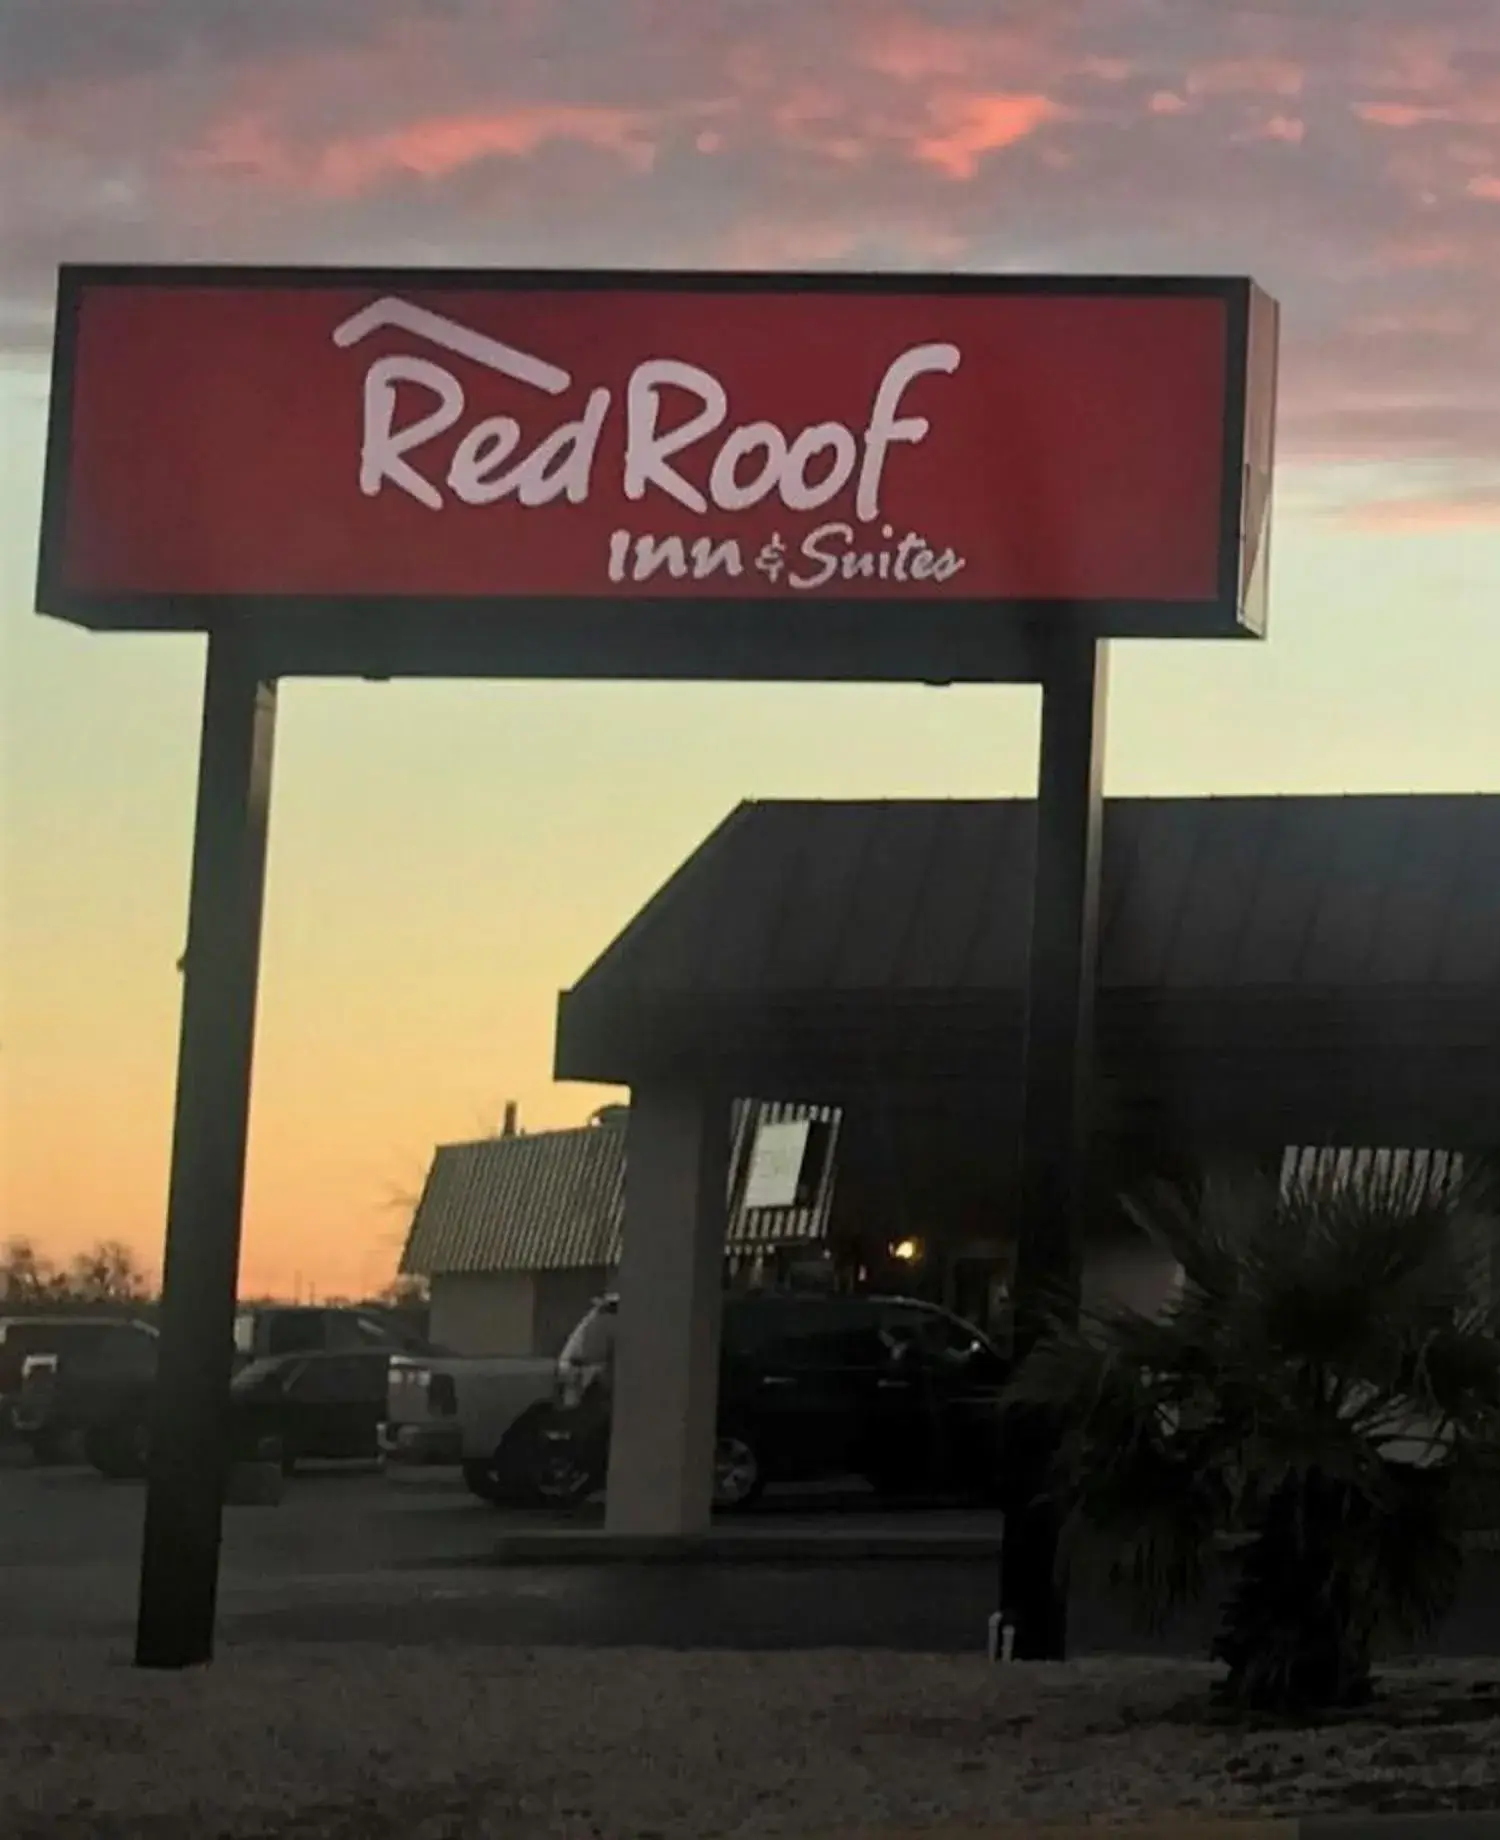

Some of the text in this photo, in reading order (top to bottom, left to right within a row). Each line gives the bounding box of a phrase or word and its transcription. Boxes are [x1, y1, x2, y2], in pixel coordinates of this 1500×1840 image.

[358, 343, 961, 522] Red Roof
[607, 523, 966, 589] Inn & Suites
